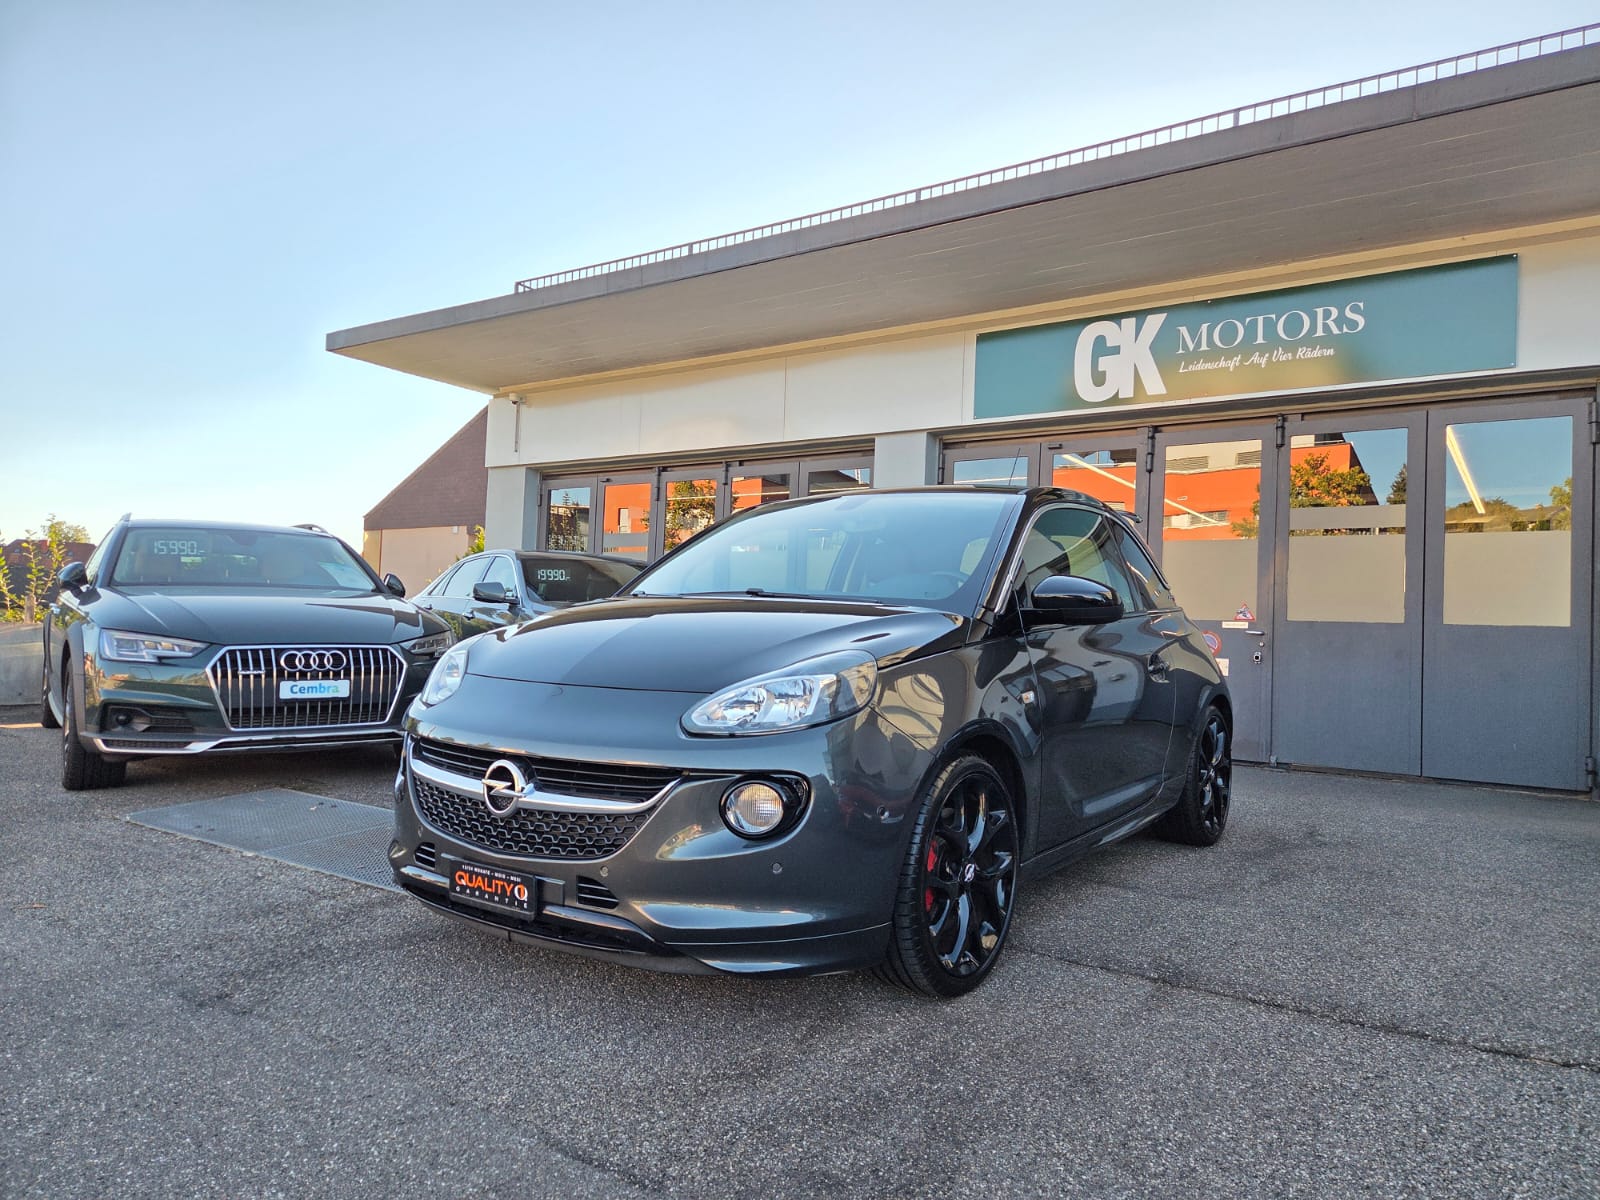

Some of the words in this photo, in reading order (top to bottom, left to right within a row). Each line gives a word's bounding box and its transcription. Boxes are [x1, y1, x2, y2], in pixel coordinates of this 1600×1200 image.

[1074, 312, 1168, 403] GK
[1176, 301, 1366, 355] MOTORS
[1179, 354, 1241, 373] Leidenschaft
[1243, 351, 1270, 368] Auf
[1272, 346, 1293, 363] Vier
[289, 683, 340, 695] Cembra
